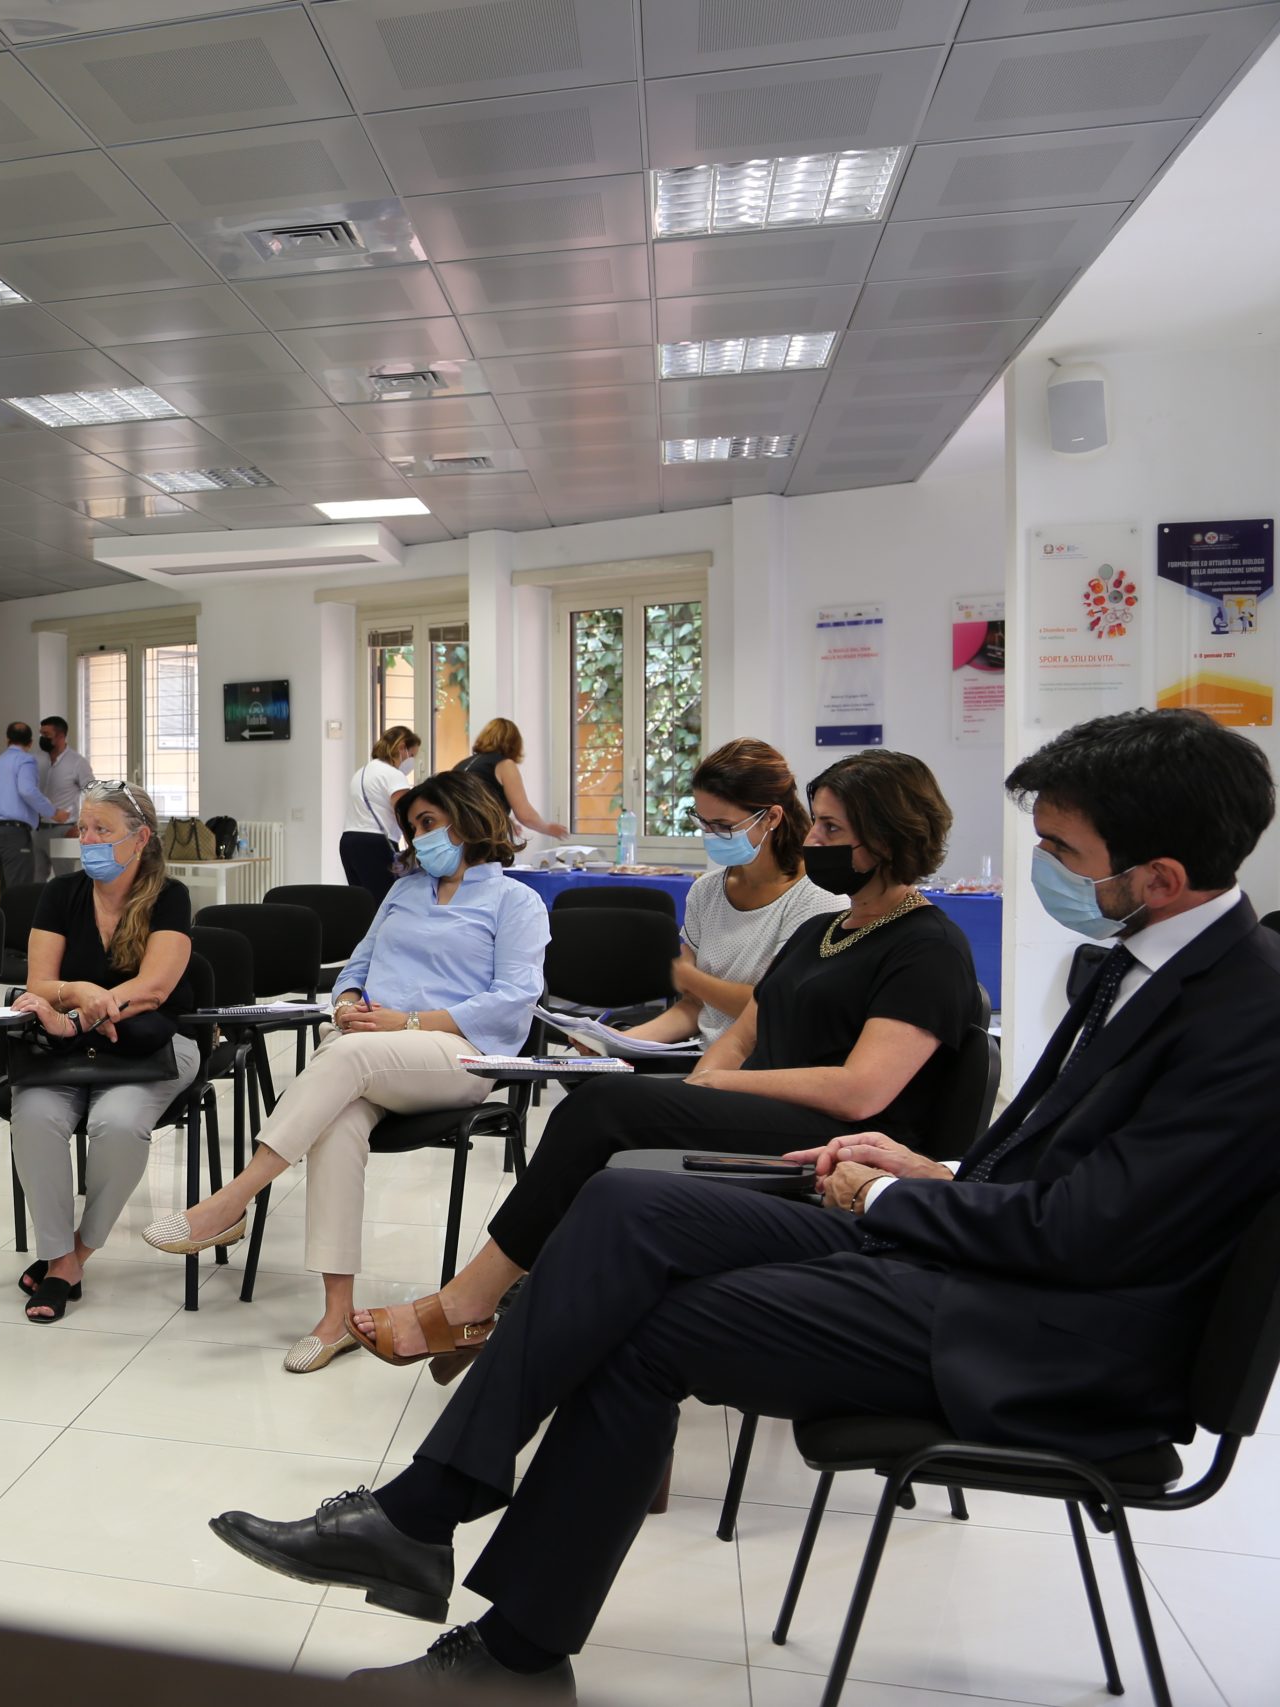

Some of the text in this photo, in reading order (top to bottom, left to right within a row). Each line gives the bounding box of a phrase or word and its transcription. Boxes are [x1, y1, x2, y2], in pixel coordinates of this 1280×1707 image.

[1167, 560, 1199, 568] FORMAZIONE
[1039, 655, 1061, 663] SPORT
[1063, 655, 1069, 663] &
[1071, 655, 1087, 663] STILI
